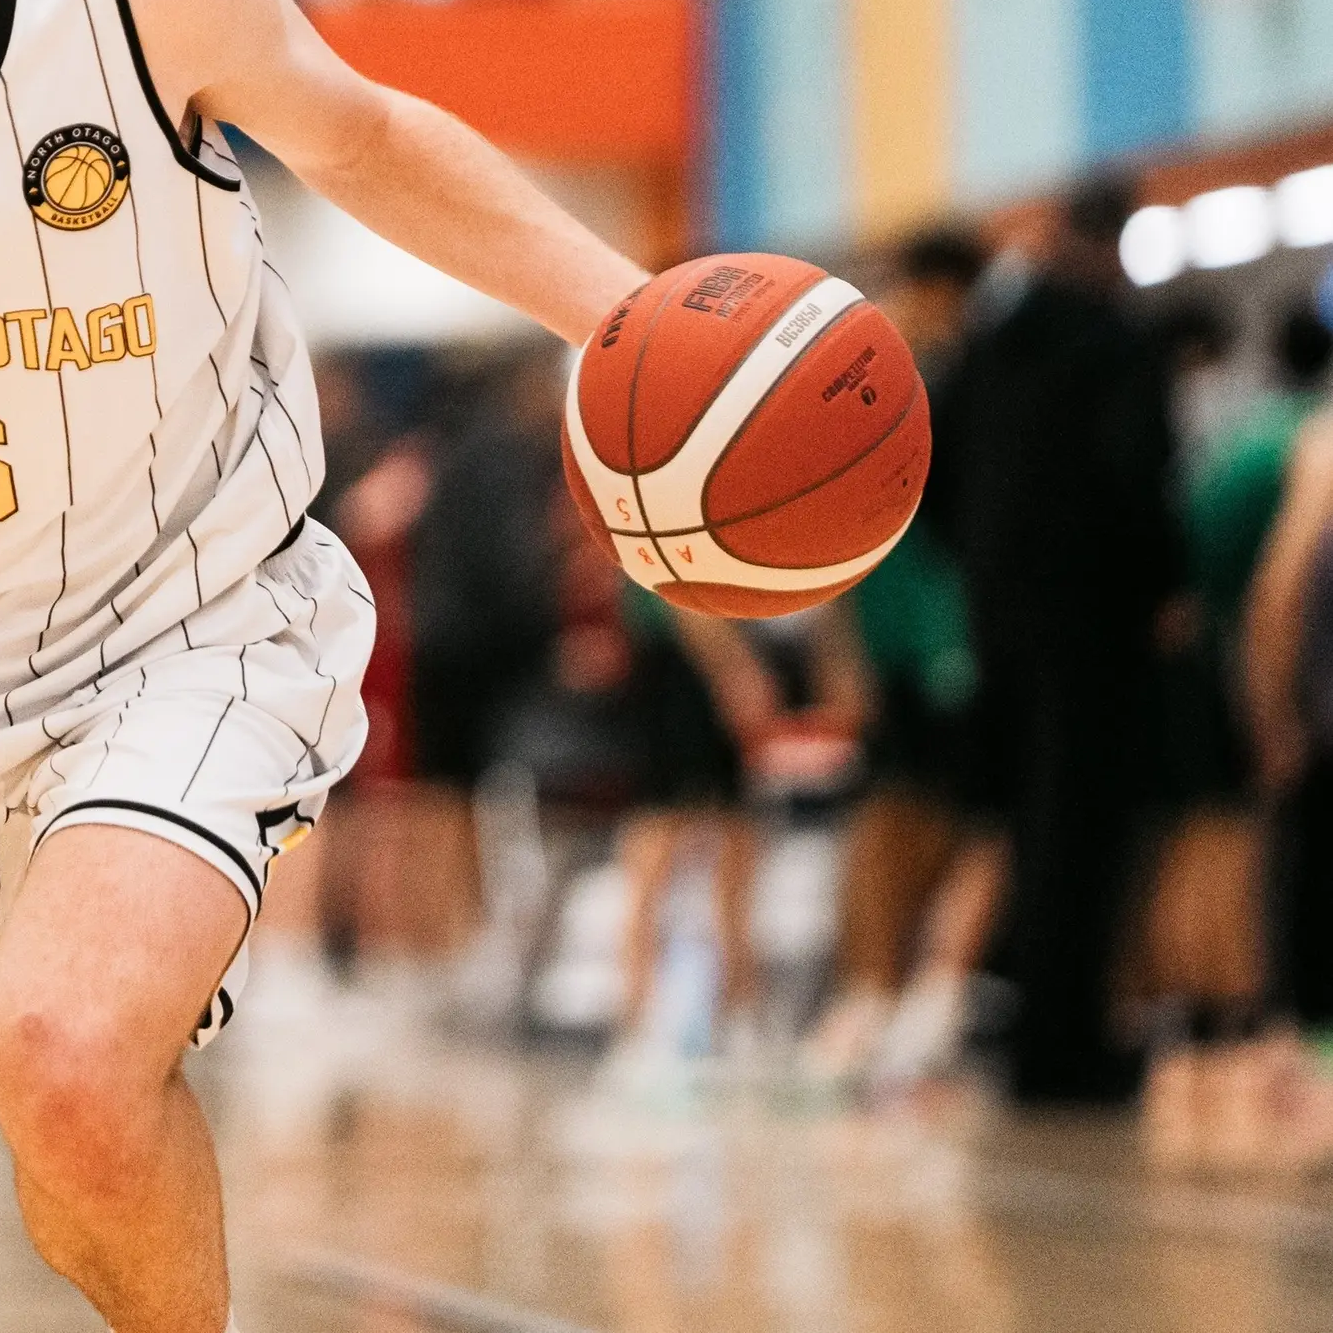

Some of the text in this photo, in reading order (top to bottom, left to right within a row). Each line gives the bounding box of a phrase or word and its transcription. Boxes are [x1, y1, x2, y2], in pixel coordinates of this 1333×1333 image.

[27, 127, 120, 179] NORTH OTAGO
[51, 196, 118, 225] BASKETBALL
[682, 266, 749, 312] FIBA
[675, 544, 693, 563] A
